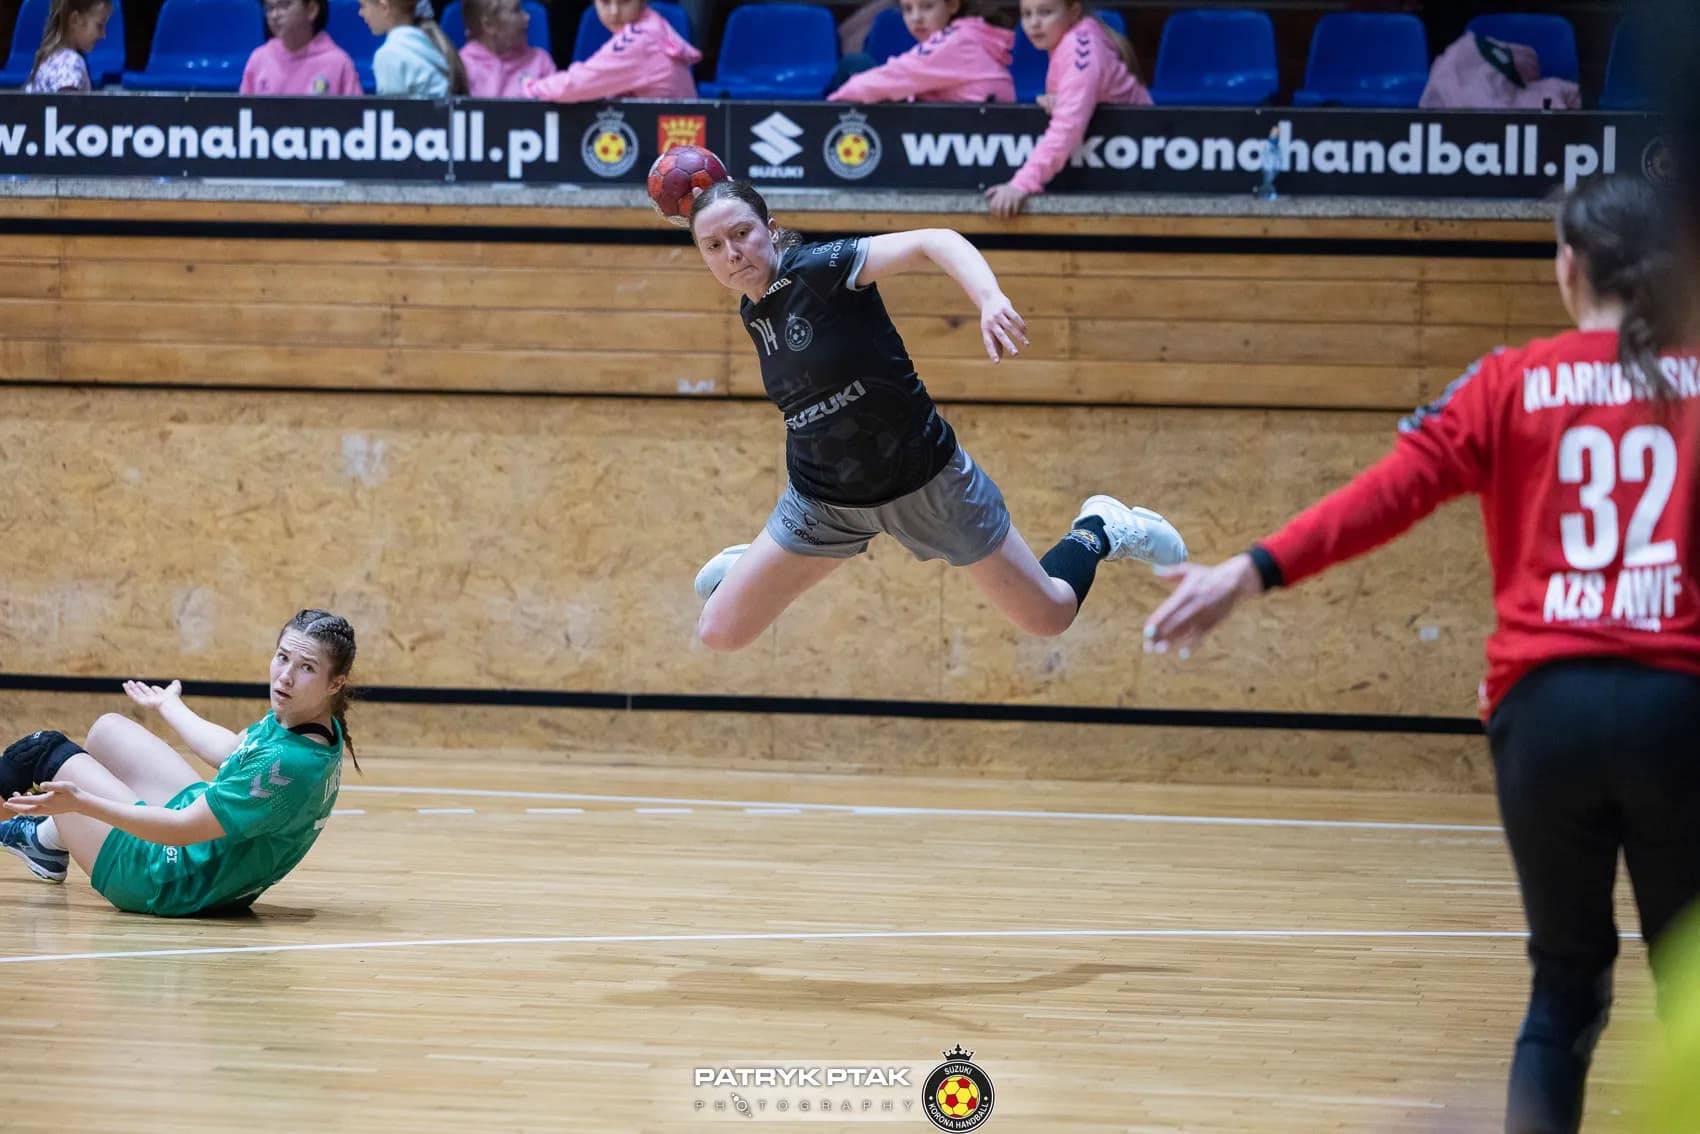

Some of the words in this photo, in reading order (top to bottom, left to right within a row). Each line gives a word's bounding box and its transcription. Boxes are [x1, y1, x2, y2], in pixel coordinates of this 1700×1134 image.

[749, 166, 804, 178] SUZUKI
[763, 278, 792, 298] oma
[750, 318, 779, 356] 14
[785, 380, 866, 431] SUZUKI
[1557, 424, 1678, 571] 32
[1543, 572, 1605, 623] AZS
[1611, 564, 1682, 619] AWF
